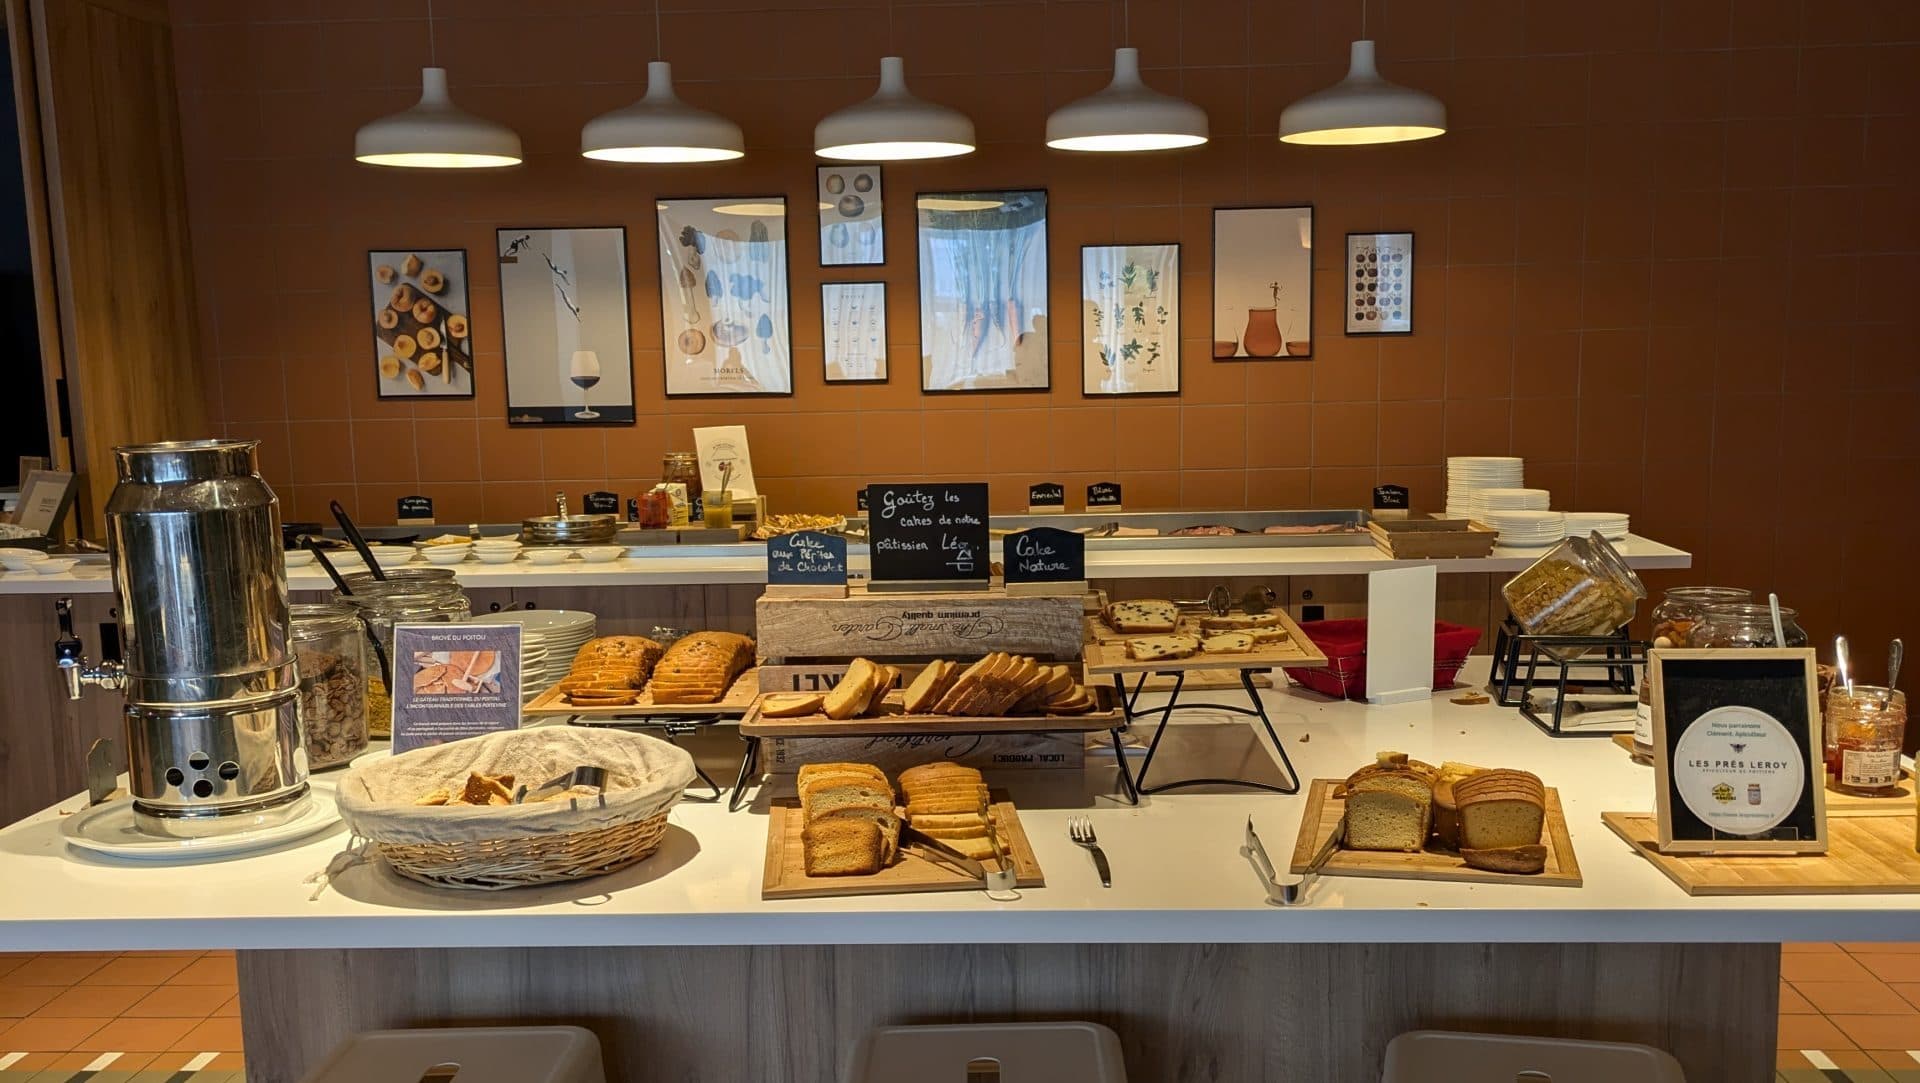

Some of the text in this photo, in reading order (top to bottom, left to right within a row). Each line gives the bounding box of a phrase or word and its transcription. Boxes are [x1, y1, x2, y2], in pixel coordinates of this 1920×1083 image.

[881, 490, 935, 519] Goûtez
[900, 514, 981, 527] cakes de notre
[789, 533, 825, 549] Cake
[1016, 535, 1056, 556] Cake
[778, 561, 794, 572] de
[1019, 558, 1071, 573] Nature
[902, 611, 980, 620] premium quality
[831, 616, 904, 641] Garden
[951, 616, 1004, 639] The
[992, 754, 1065, 763] LOCAL PRODUCT
[1750, 761, 1787, 769] LEROY
